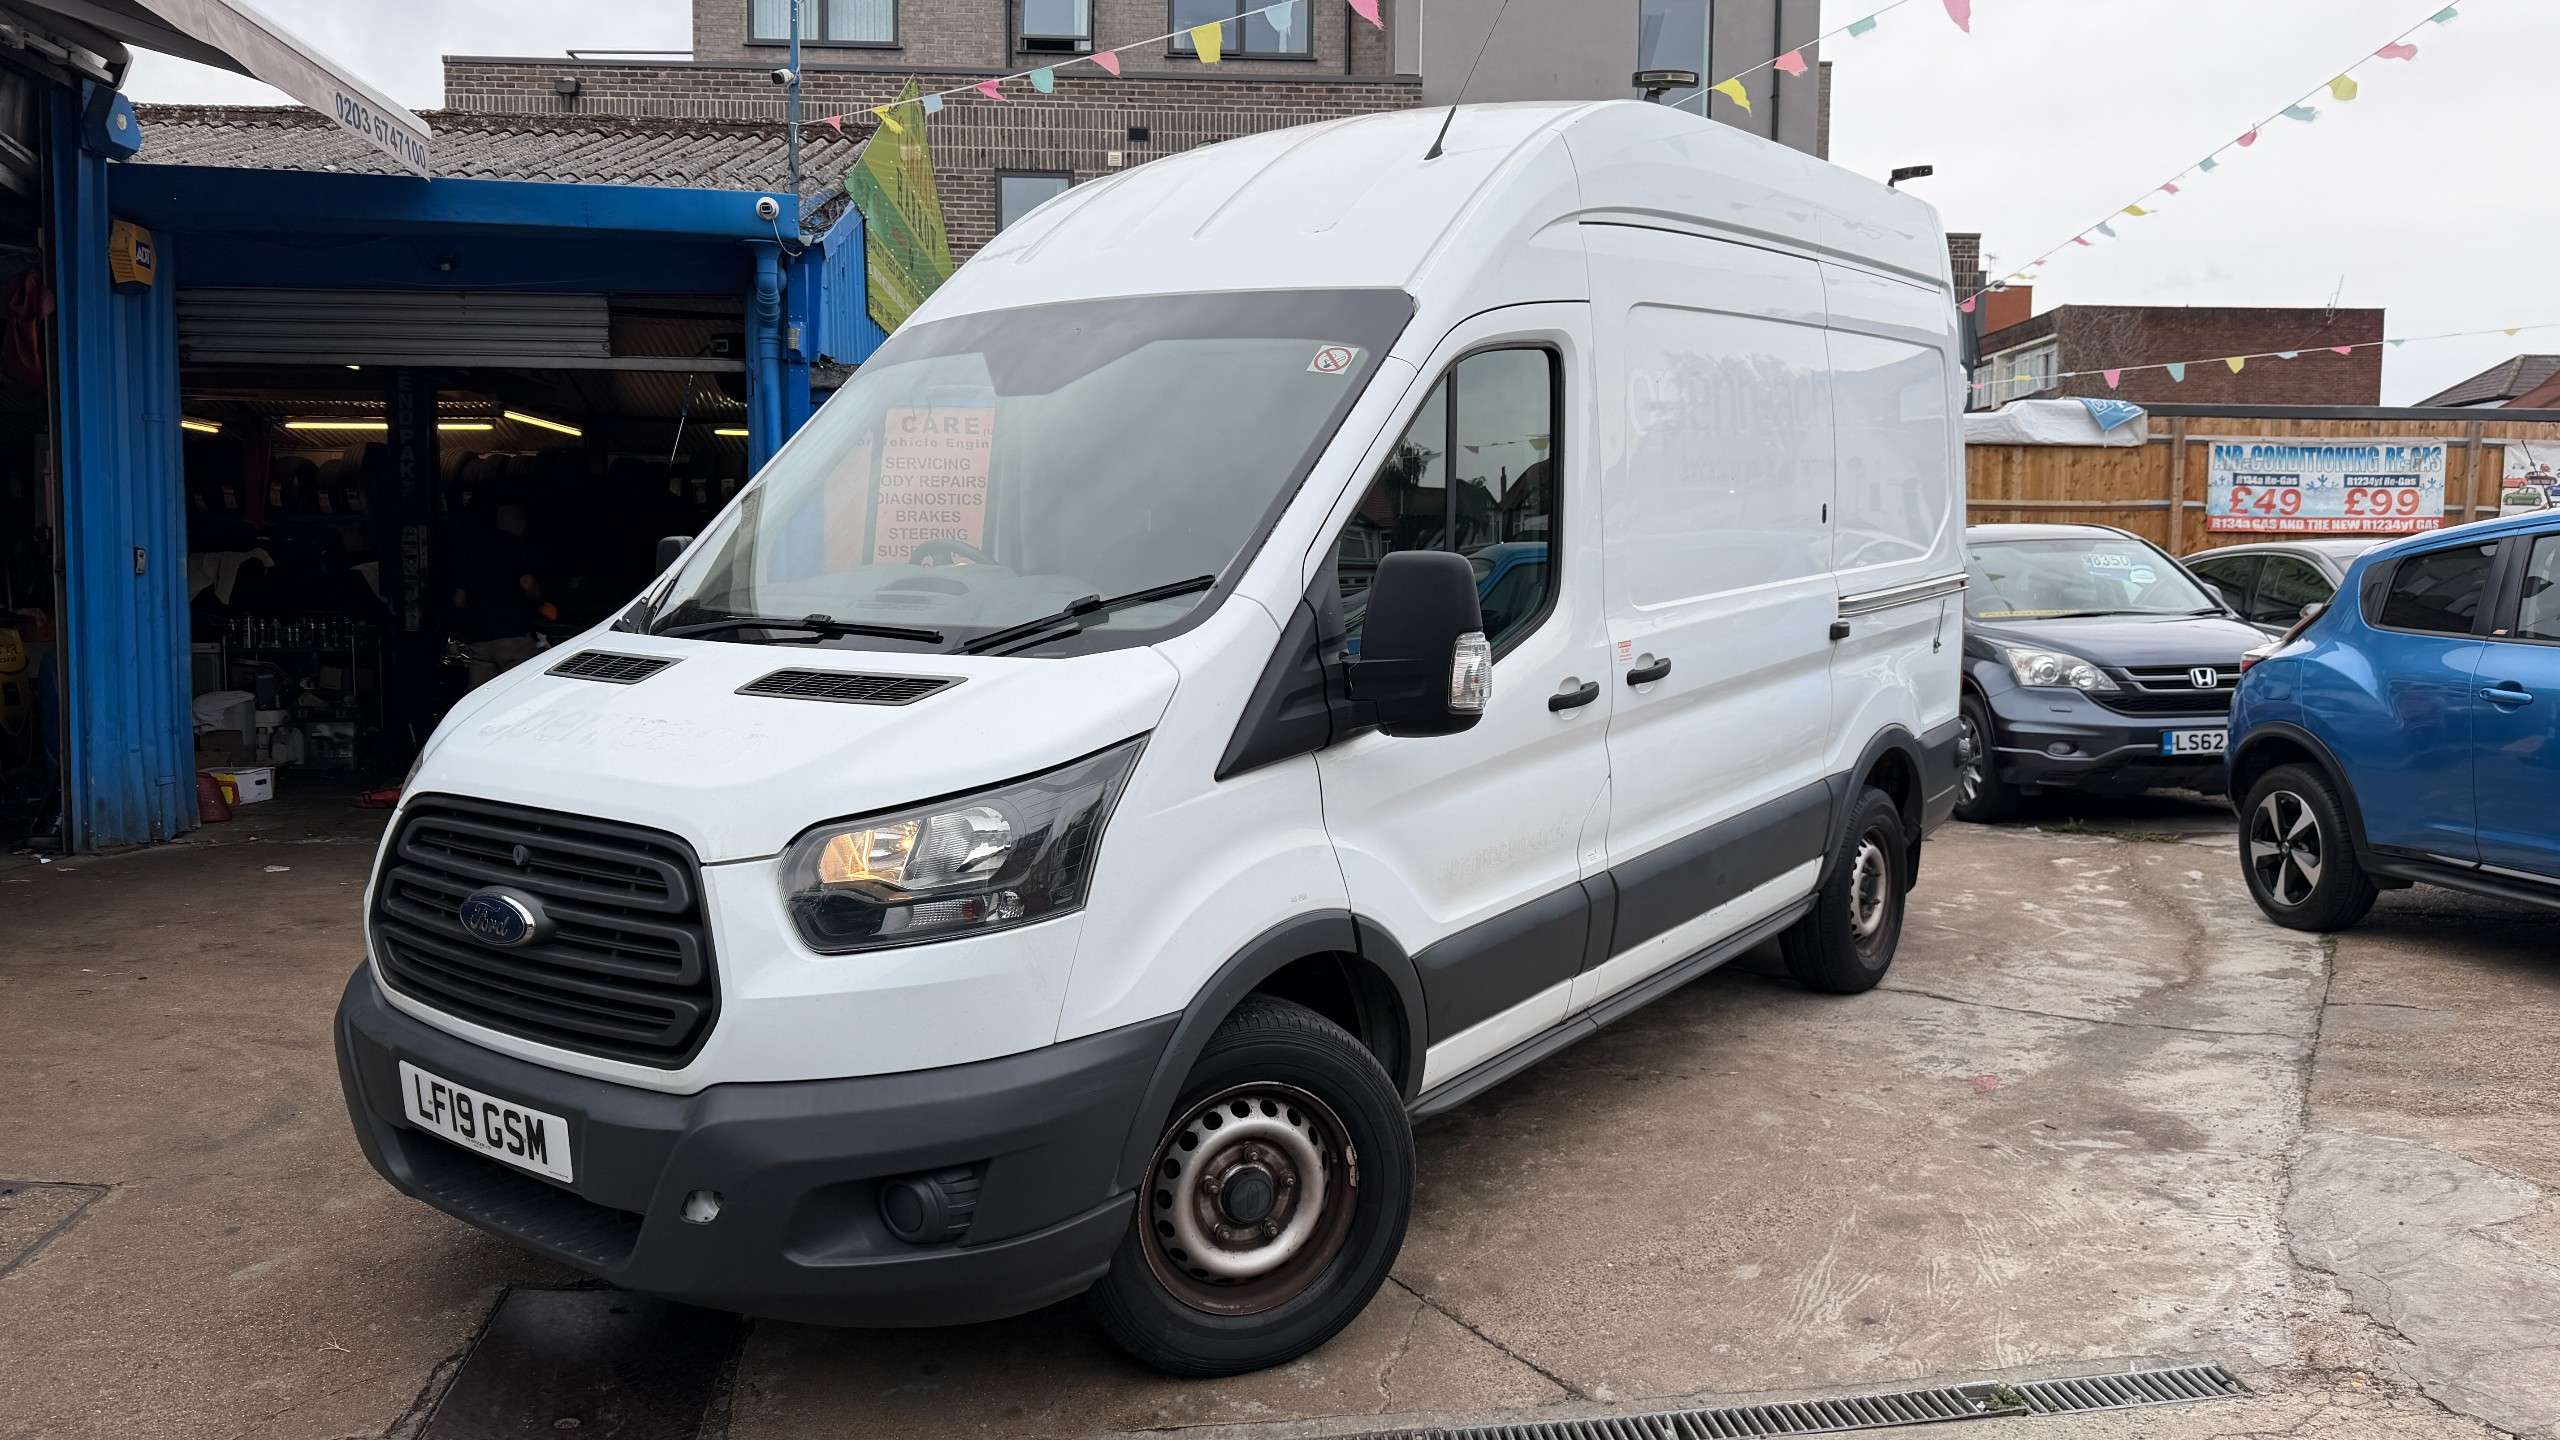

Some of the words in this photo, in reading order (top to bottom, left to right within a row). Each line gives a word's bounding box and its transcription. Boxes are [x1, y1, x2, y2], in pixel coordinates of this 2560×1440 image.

[335, 91, 371, 134] 0203
[374, 115, 426, 169] 6747100
[136, 246, 150, 264] ADT
[901, 415, 980, 435] CARE
[883, 437, 937, 447] ehicle
[946, 438, 989, 450] Engin
[885, 456, 971, 471] SERVICING
[2213, 445, 2380, 473] AIR-CONDITIONING
[2384, 446, 2442, 473] RE-GAS
[919, 475, 986, 489] REPAIRS
[2229, 486, 2302, 516] £49
[2344, 486, 2420, 516] £99
[895, 510, 961, 523] BRAKES
[2211, 517, 2250, 529] R134a
[2251, 518, 2278, 530] GAS
[2279, 518, 2305, 530] AND
[2306, 519, 2330, 530] THE
[2331, 519, 2361, 530] NEW
[2362, 519, 2414, 530] R1234yf
[2415, 519, 2441, 530] GAS
[888, 527, 968, 540] STEERING
[2175, 733, 2225, 751] LS62
[469, 902, 511, 937] Ford
[414, 1074, 476, 1139] LF19
[482, 1101, 548, 1165] GSM
